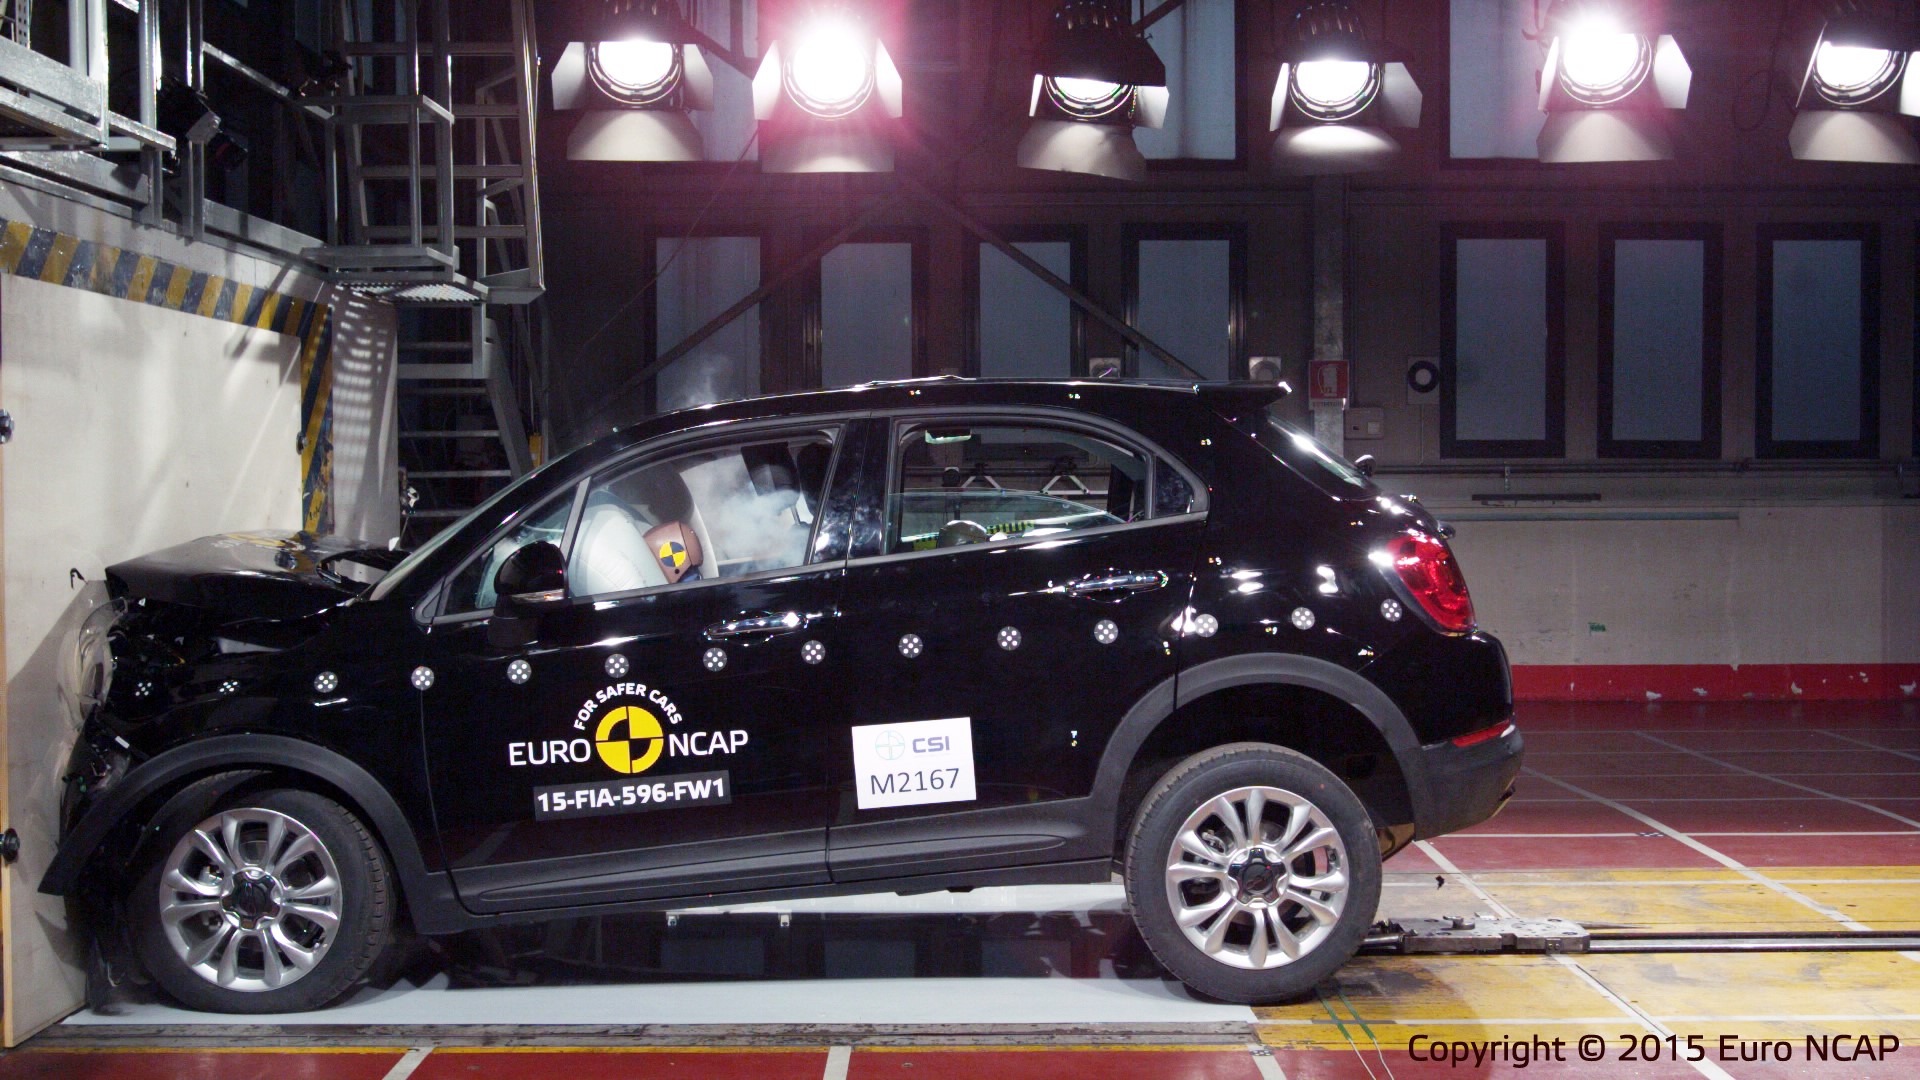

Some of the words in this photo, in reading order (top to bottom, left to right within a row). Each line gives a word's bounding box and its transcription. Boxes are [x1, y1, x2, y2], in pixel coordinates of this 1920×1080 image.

[573, 699, 599, 731] FOR
[595, 682, 647, 704] SAFER
[649, 689, 682, 725] CARS
[509, 739, 590, 765] EURO
[669, 730, 748, 756] NCAP
[912, 735, 950, 753] CSI
[538, 778, 723, 811] 15-FIA-596-FW1
[870, 767, 960, 795] M2167
